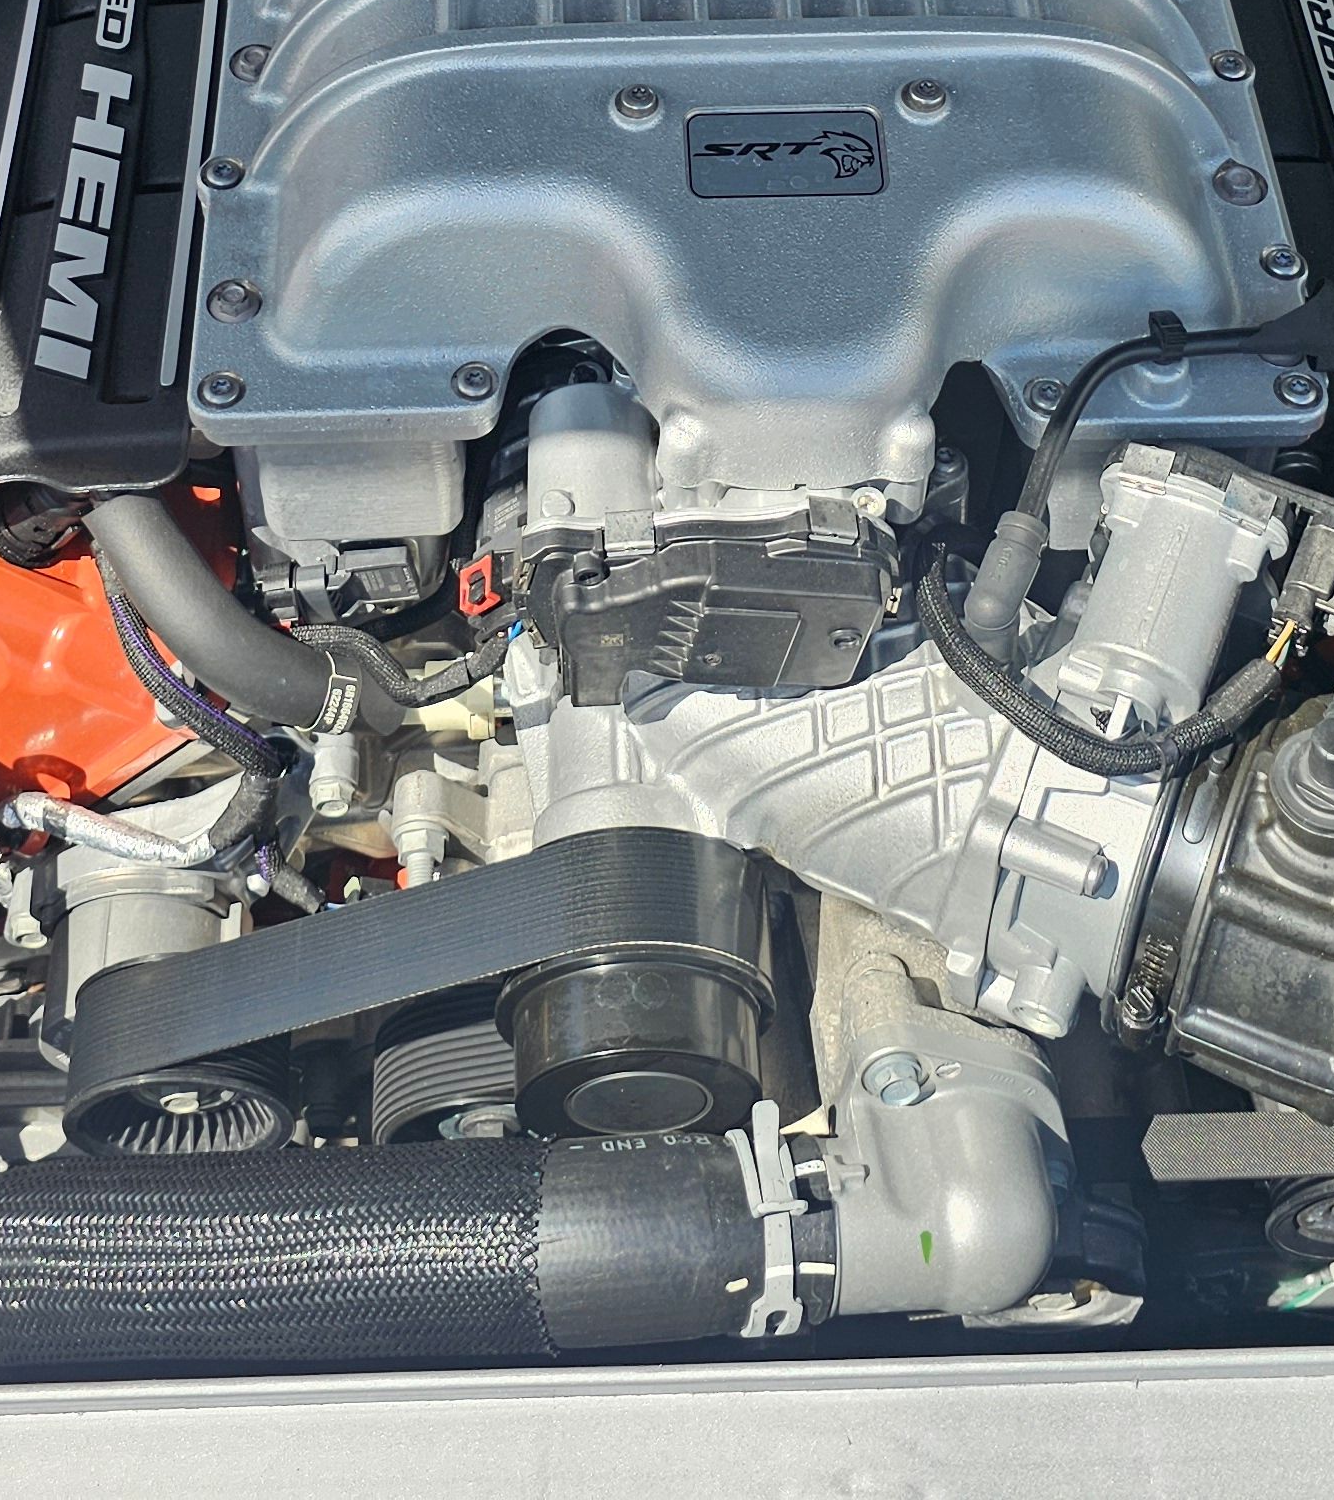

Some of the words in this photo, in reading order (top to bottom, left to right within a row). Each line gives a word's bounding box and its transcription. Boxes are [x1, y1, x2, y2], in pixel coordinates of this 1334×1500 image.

[692, 142, 824, 162] SRT
[34, 63, 133, 380] HEMI
[602, 1138, 647, 1152] END
